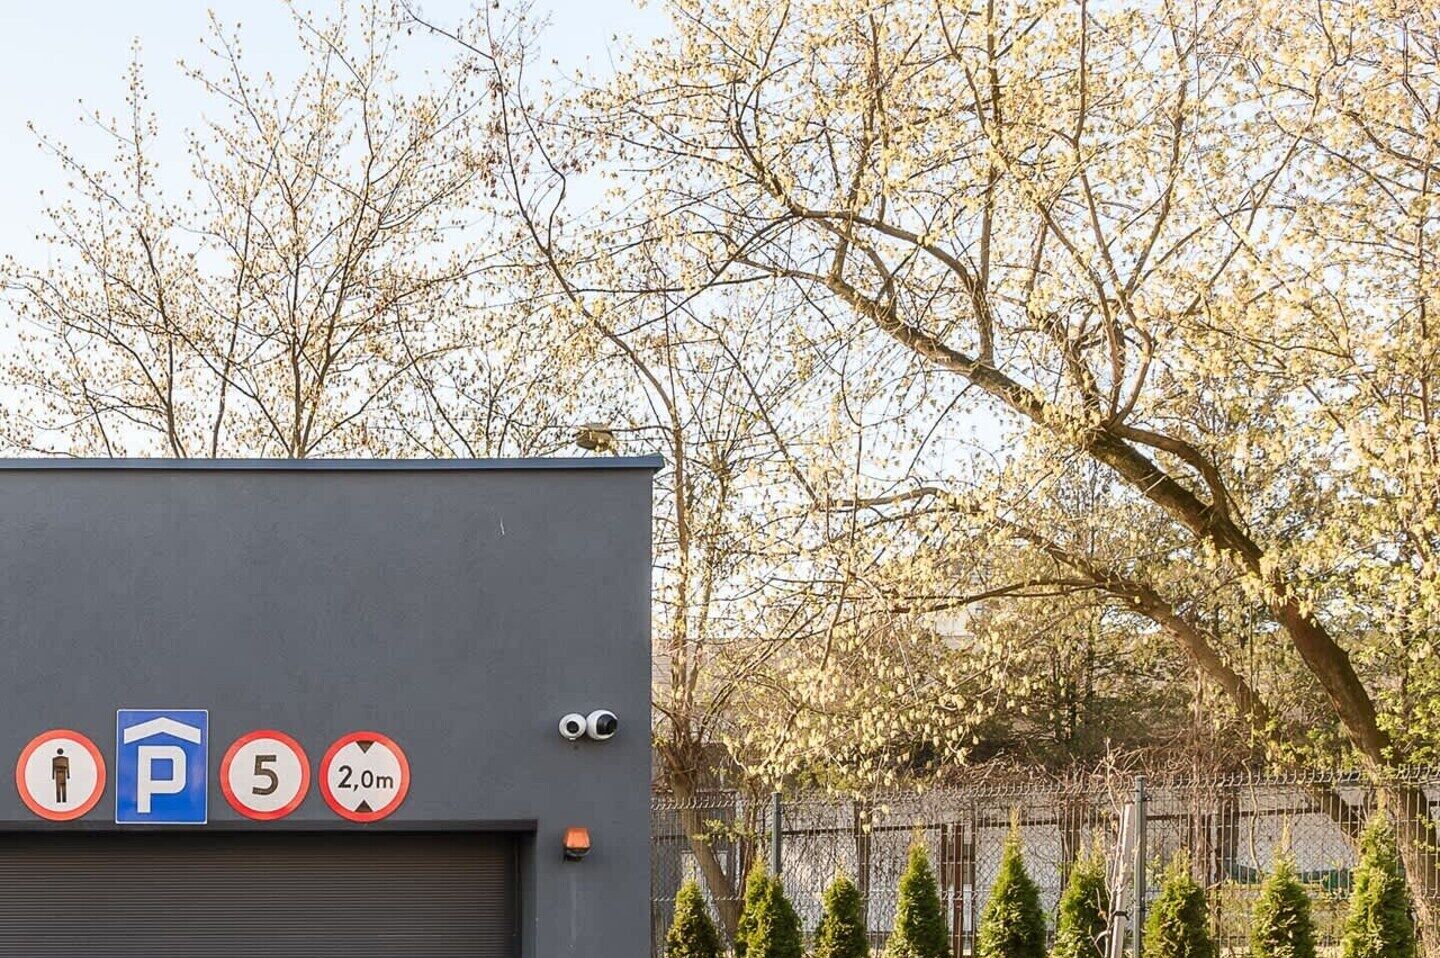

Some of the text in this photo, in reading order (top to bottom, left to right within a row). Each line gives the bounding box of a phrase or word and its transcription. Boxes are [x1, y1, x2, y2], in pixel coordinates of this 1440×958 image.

[137, 745, 186, 813] P
[252, 755, 279, 796] 5
[338, 765, 394, 792] 2,0m
